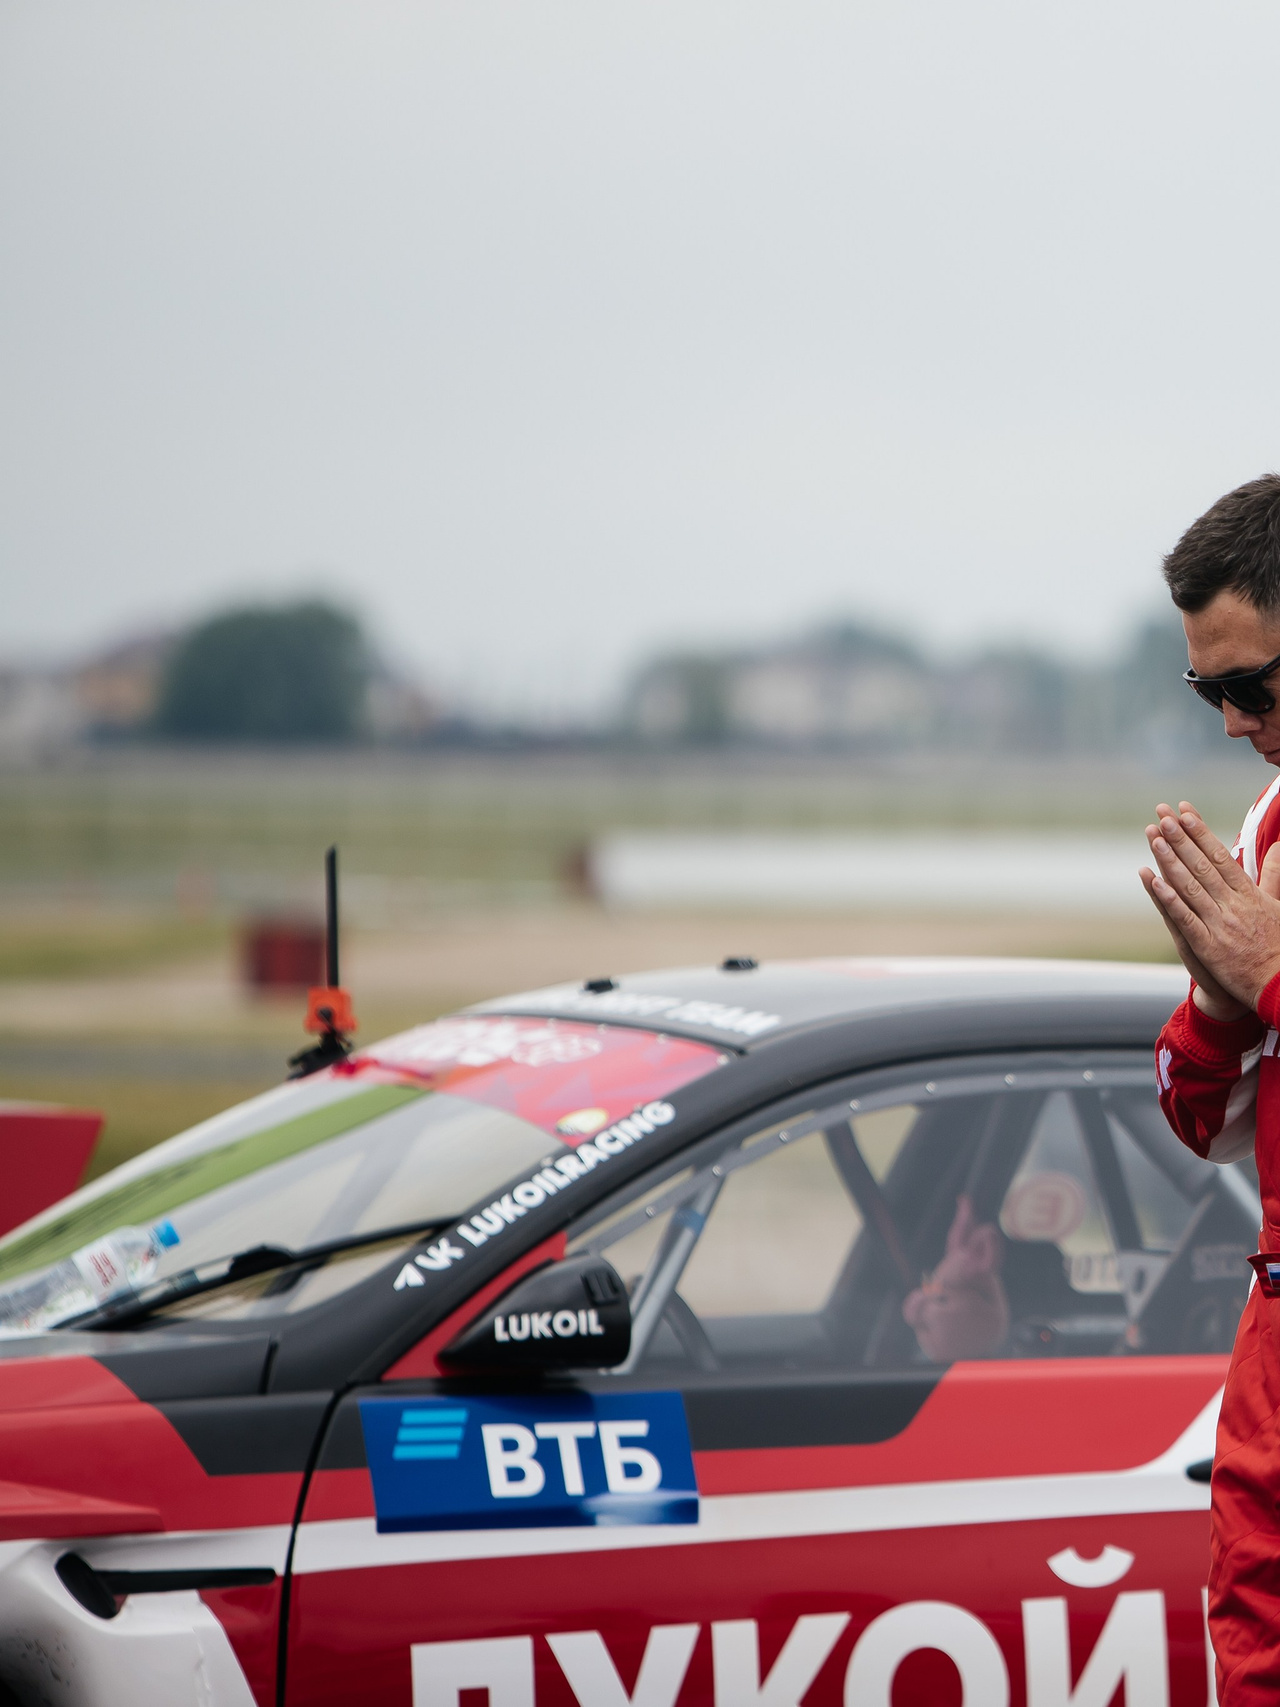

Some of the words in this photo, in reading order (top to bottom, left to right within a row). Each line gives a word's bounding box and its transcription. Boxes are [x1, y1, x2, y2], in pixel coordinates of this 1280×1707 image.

[456, 1100, 677, 1248] LUKOILRACING
[494, 1309, 604, 1342] LUKOIL
[481, 1419, 662, 1499] ВТБ
